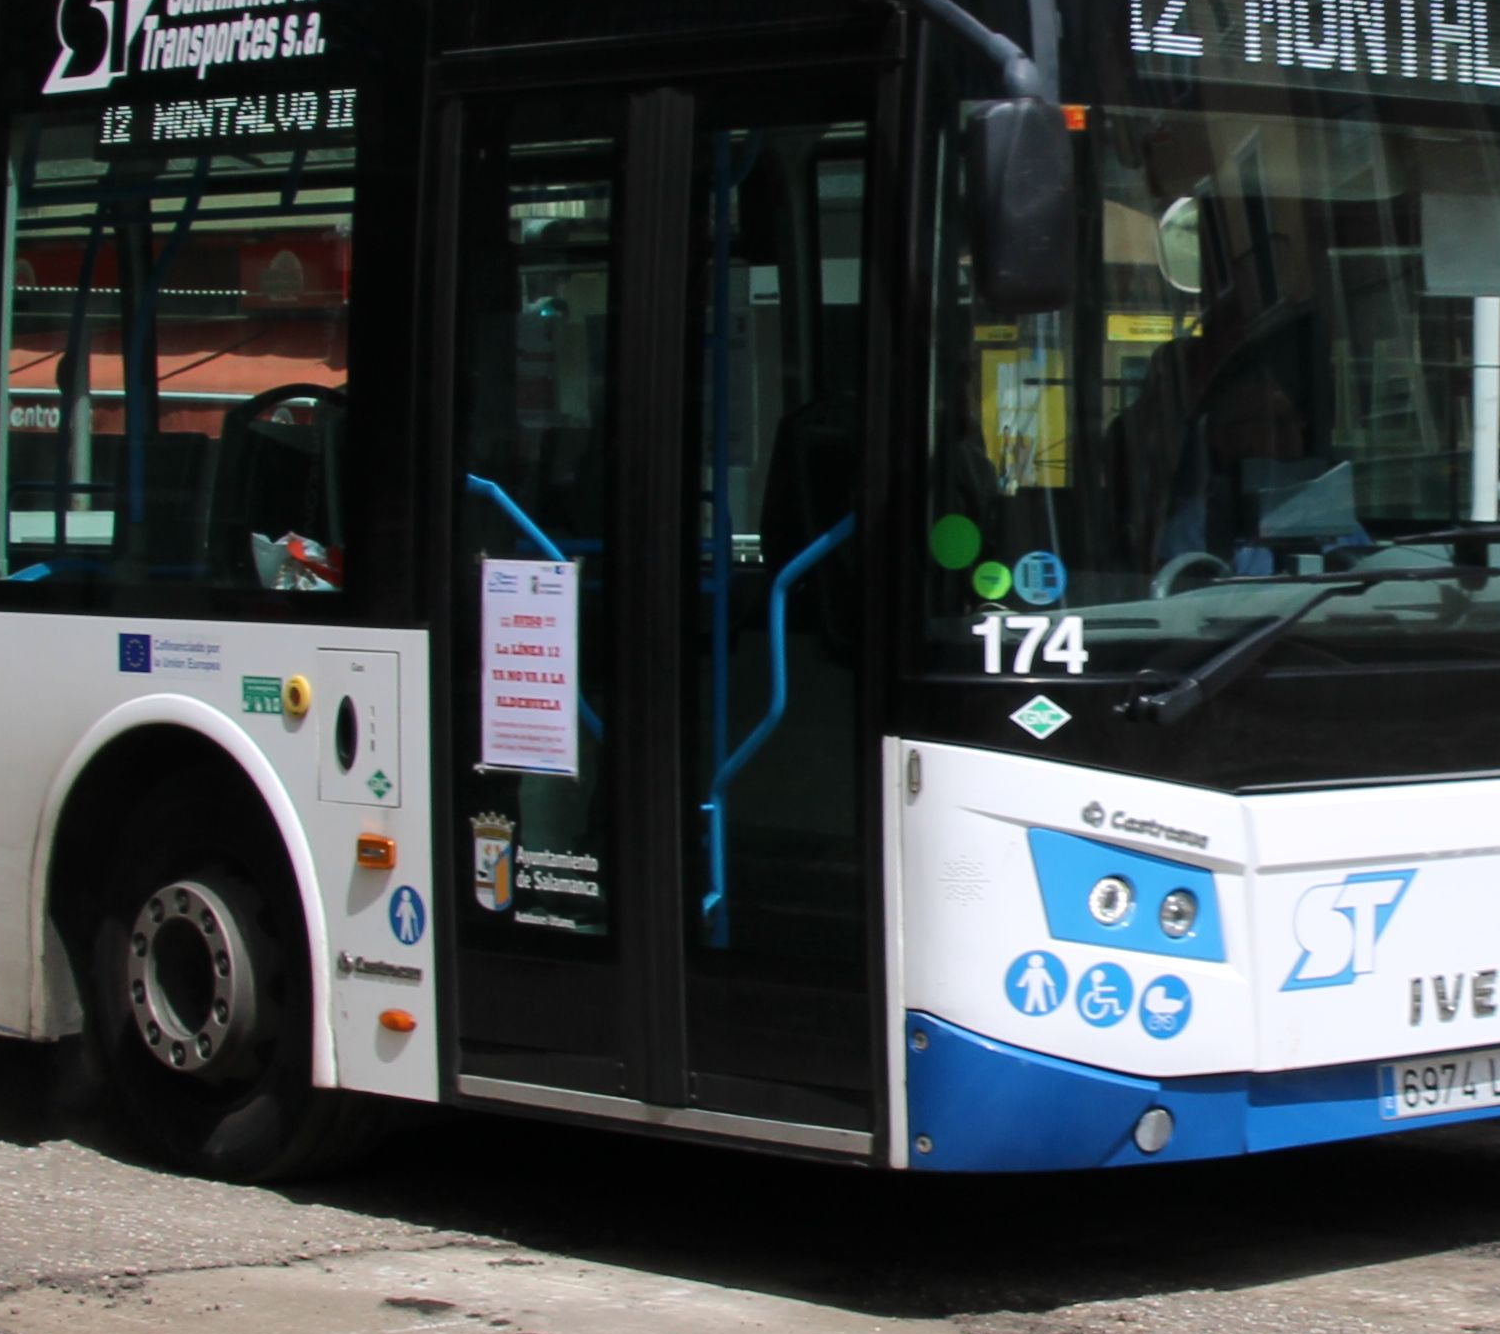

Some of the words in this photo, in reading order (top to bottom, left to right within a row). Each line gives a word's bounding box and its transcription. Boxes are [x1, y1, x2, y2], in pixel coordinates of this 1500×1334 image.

[140, 12, 280, 80] Transportes
[280, 11, 326, 58] s.a.
[99, 104, 133, 144] 12
[151, 91, 319, 141] MONTALVO
[325, 87, 357, 129] II
[971, 615, 1089, 674] 174
[515, 844, 600, 873] Ayuntamiento
[515, 869, 532, 889] de
[533, 870, 600, 897] Salamanca
[1402, 1057, 1480, 1109] 6974
